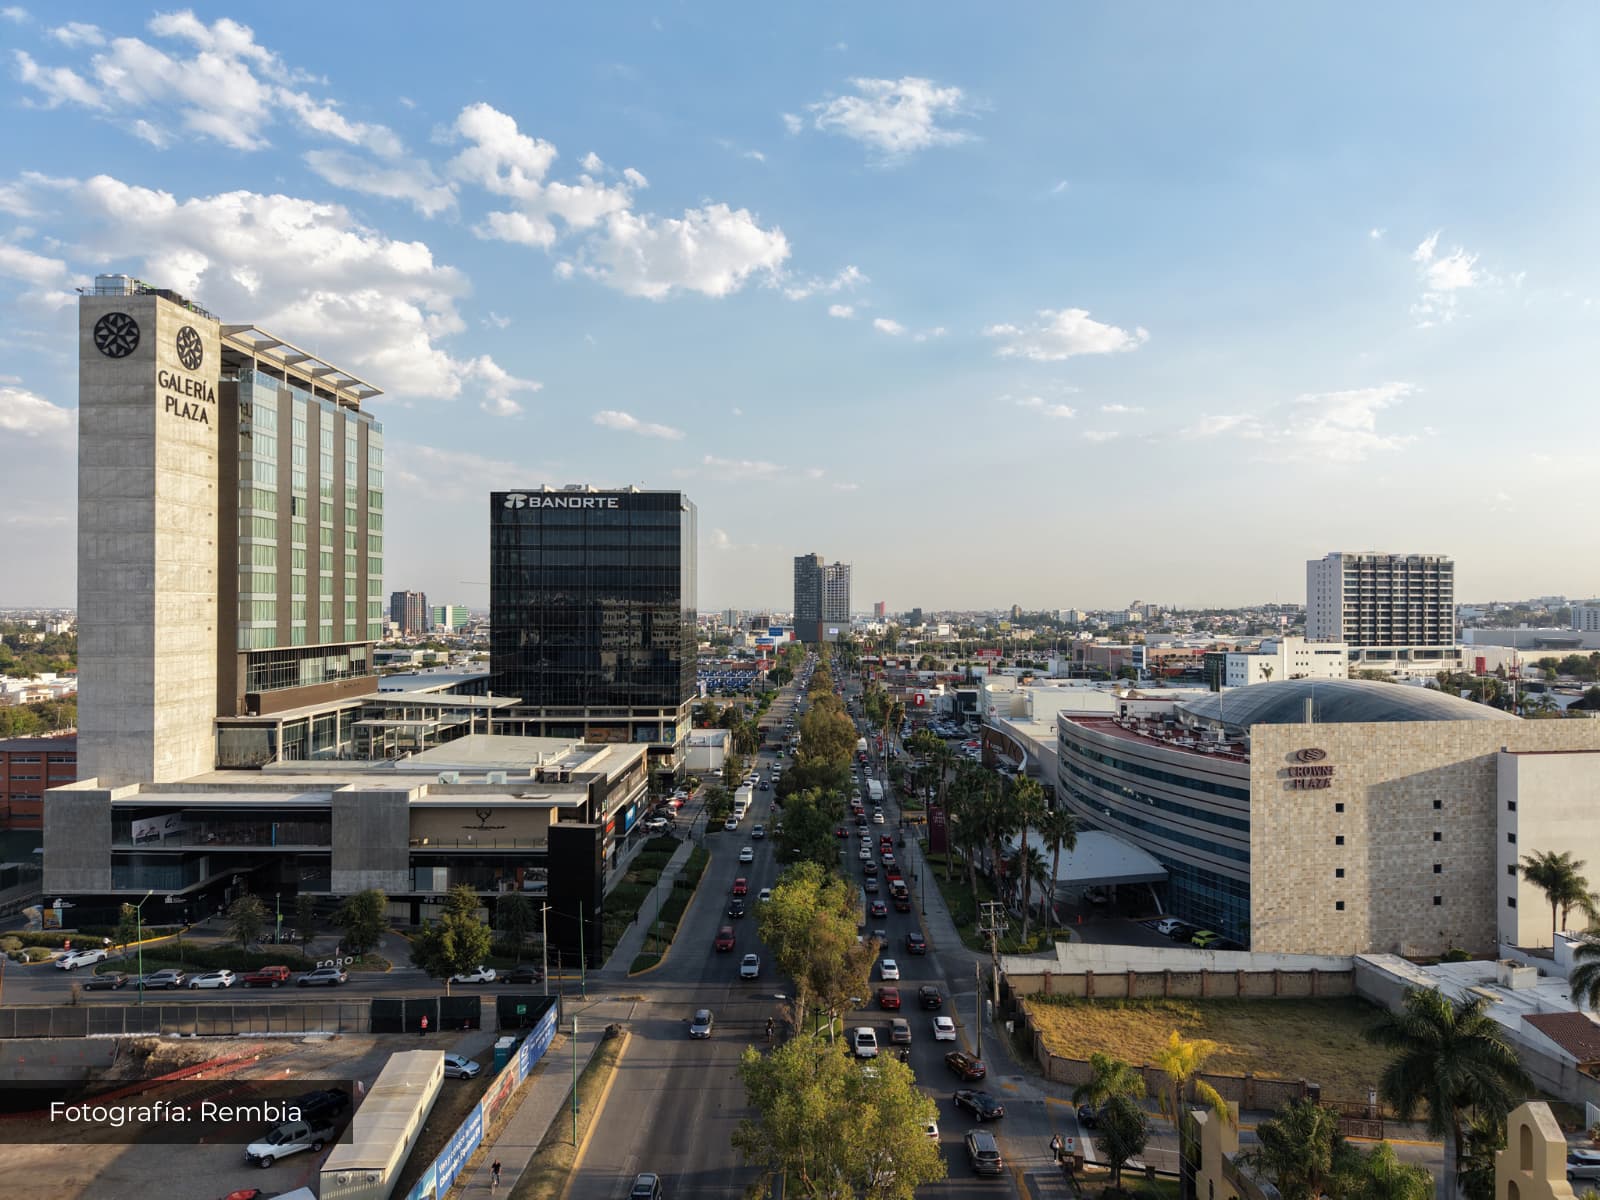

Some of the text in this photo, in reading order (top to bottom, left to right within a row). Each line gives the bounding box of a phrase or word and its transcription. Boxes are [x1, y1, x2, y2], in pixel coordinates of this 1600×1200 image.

[158, 370, 216, 404] GALERÍA
[165, 395, 209, 425] PLAZA
[529, 497, 619, 508] BANORTE
[1289, 766, 1336, 777] CROWNE
[1295, 778, 1332, 789] PLAZA
